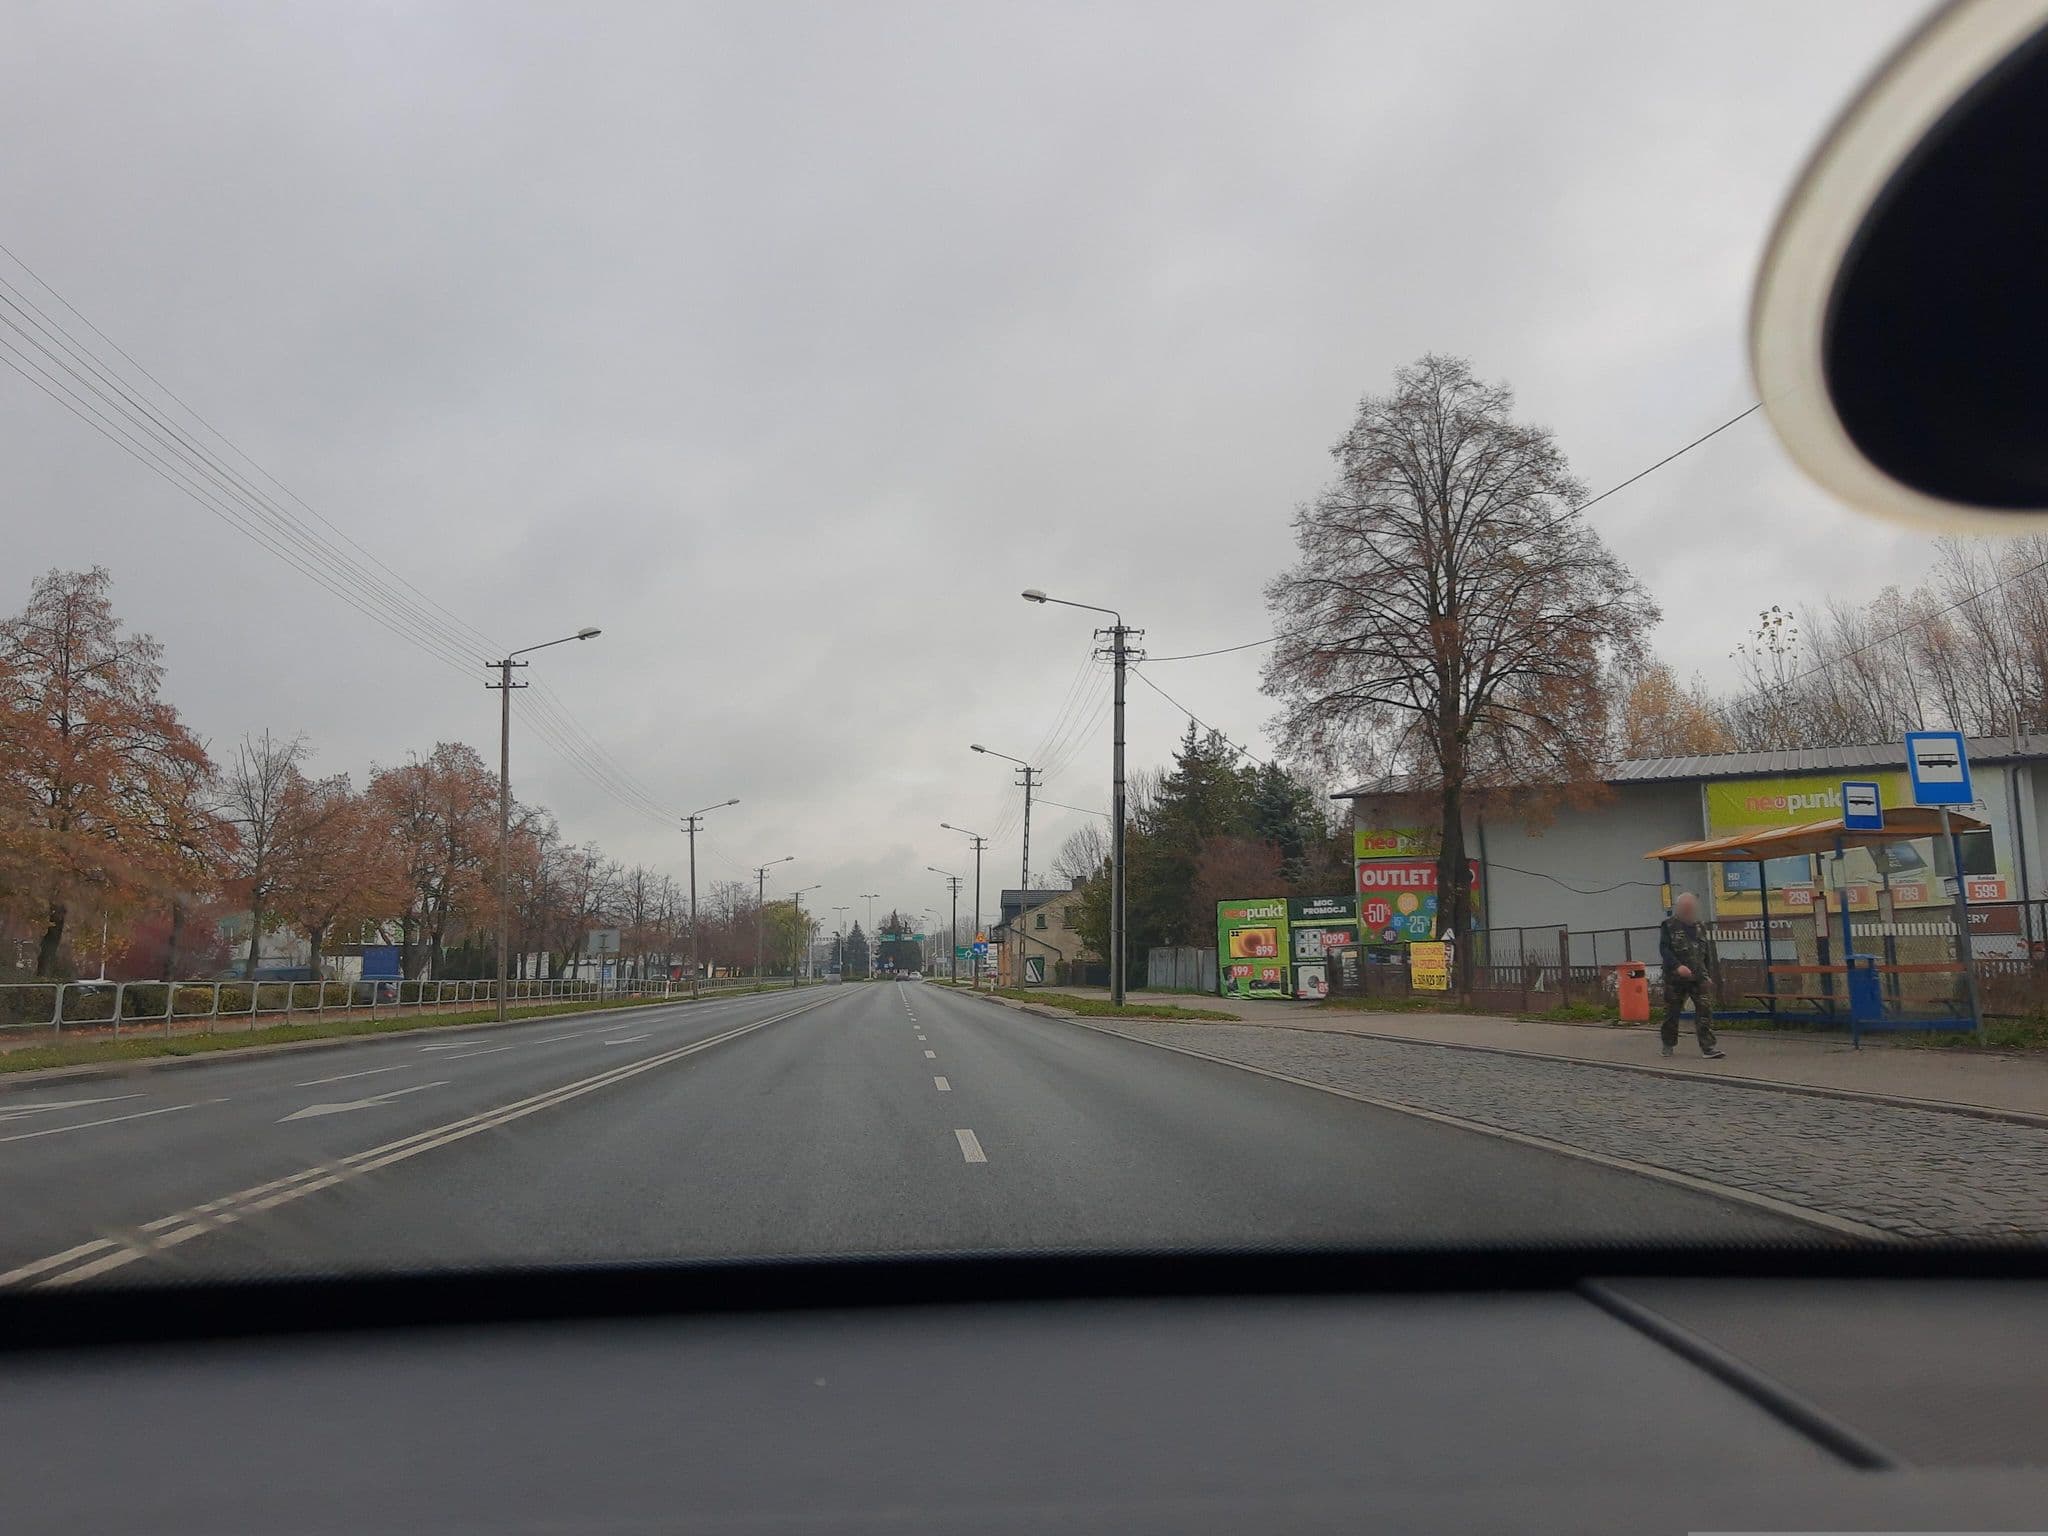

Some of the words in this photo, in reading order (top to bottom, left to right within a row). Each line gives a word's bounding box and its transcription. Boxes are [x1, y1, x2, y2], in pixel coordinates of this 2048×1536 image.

[1745, 788, 1842, 815] neopunk
[1362, 869, 1431, 886] OUTLET
[1975, 884, 1998, 898] 599
[1313, 899, 1334, 907] MOC
[1302, 906, 1347, 915] PROMOCJI
